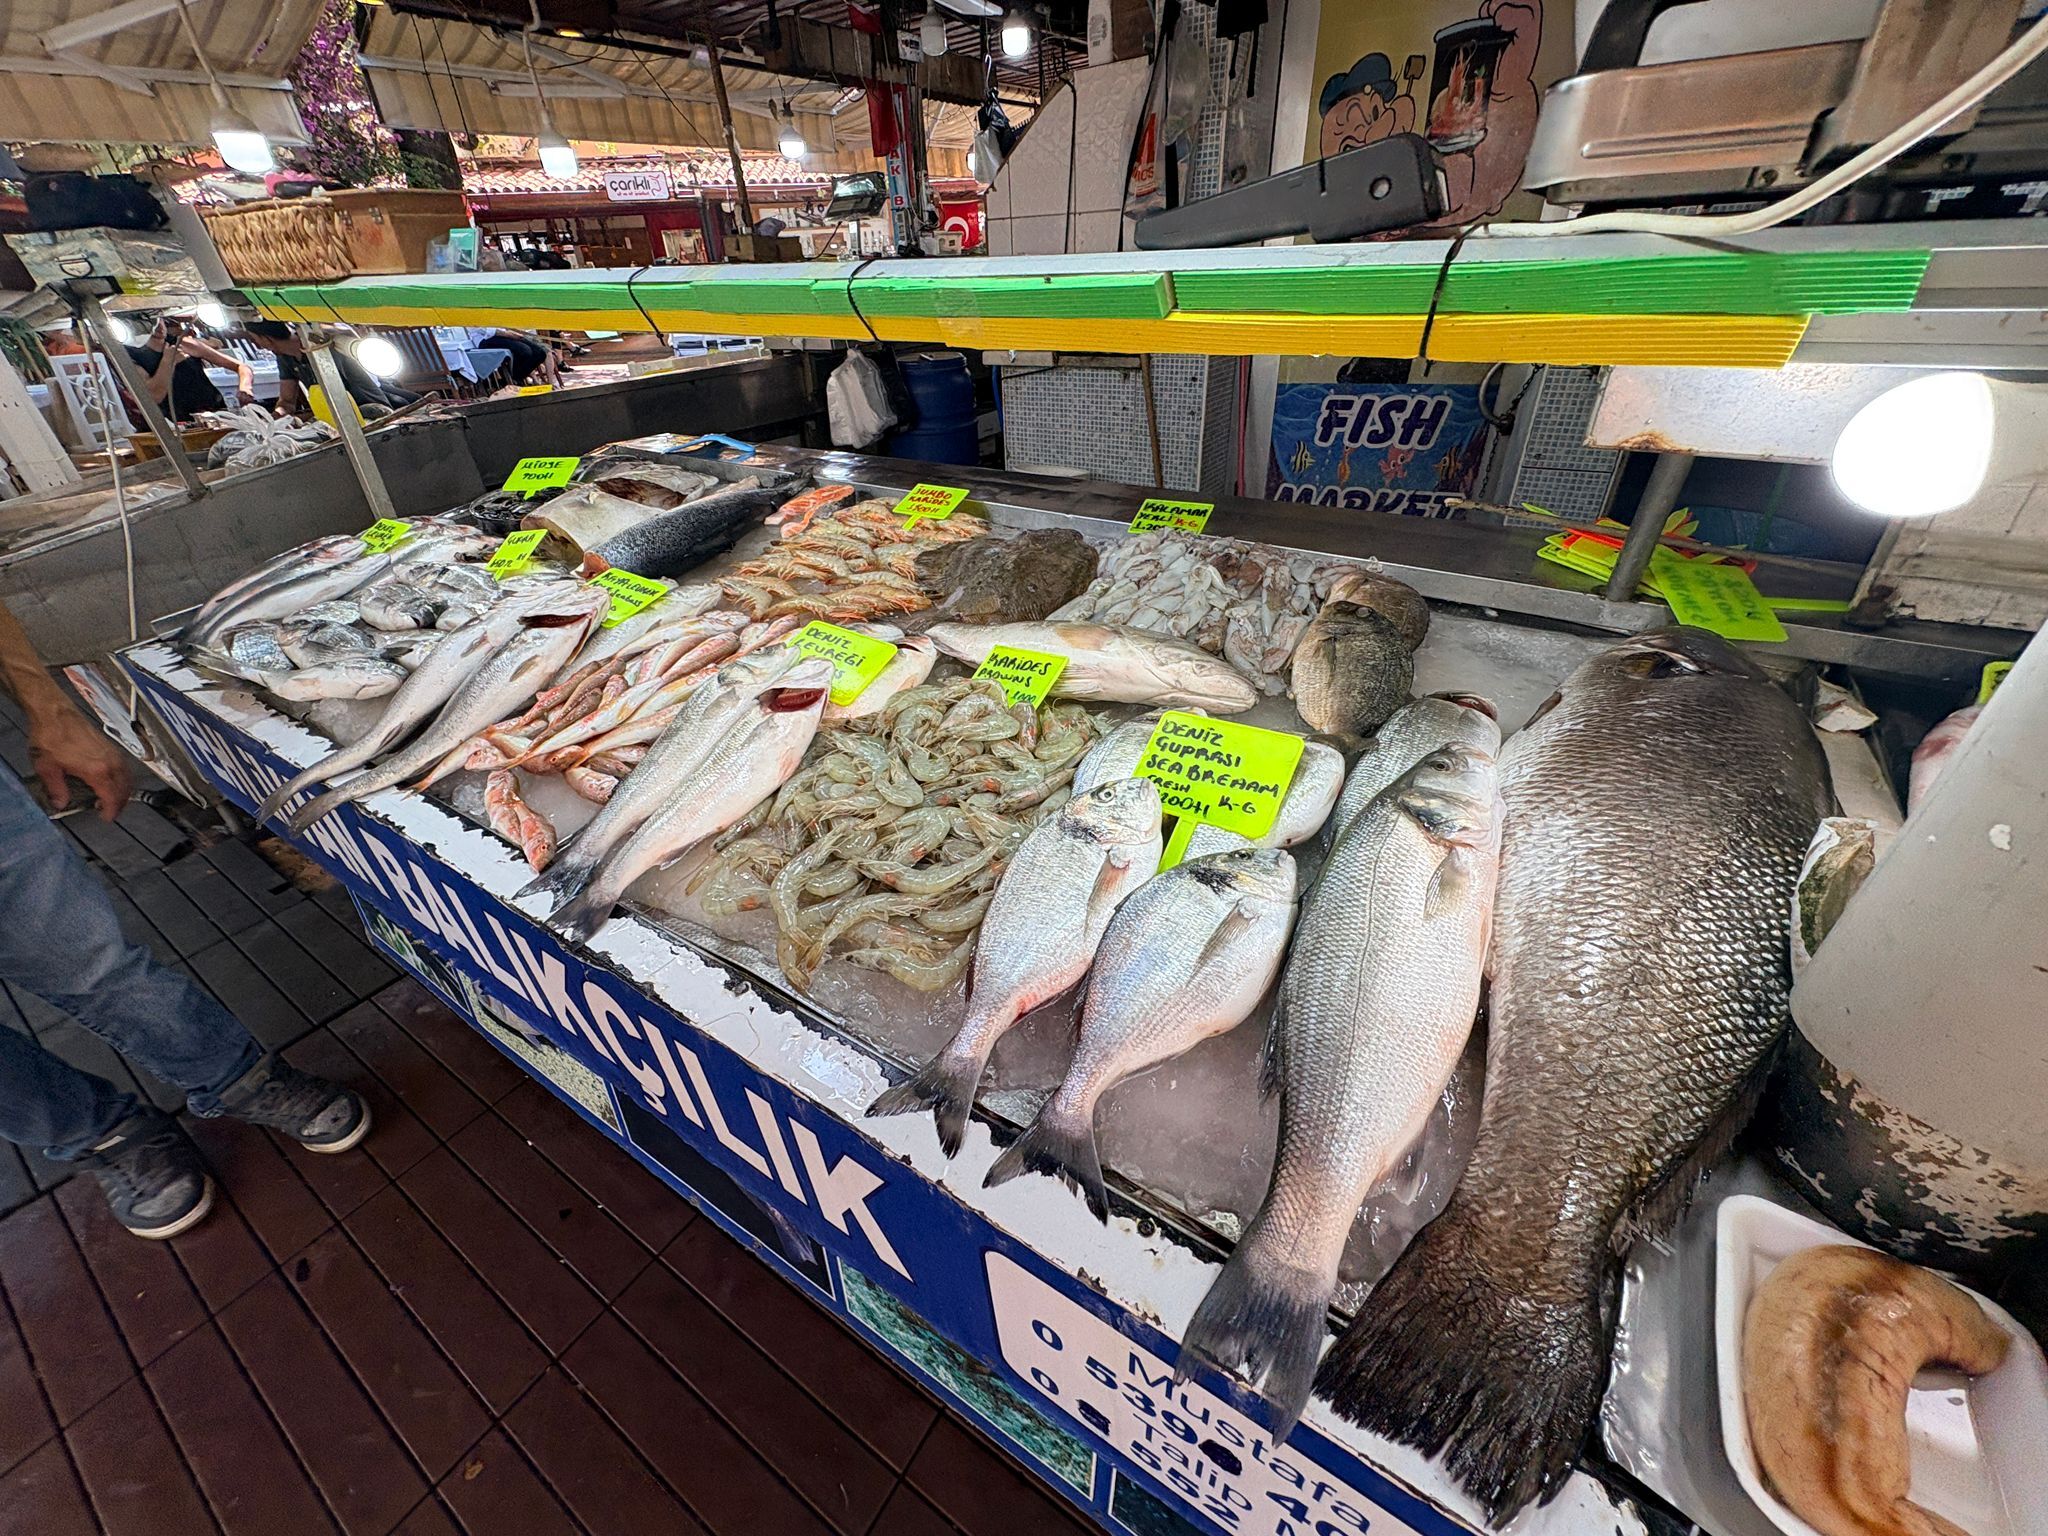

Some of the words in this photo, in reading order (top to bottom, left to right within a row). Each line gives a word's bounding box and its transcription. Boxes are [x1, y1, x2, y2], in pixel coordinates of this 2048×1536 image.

[1314, 394, 1454, 450] FISH
[806, 627, 852, 650] DENİZ
[1146, 754, 1183, 775] SEA
[1161, 720, 1224, 747] DENİZ
[357, 826, 915, 1284] BALIKÇILIK
[1084, 1355, 1199, 1446] 539
[1128, 1350, 1371, 1535] Mustafa
[1129, 1439, 1241, 1531] 552
[1132, 1413, 1254, 1512] Talip
